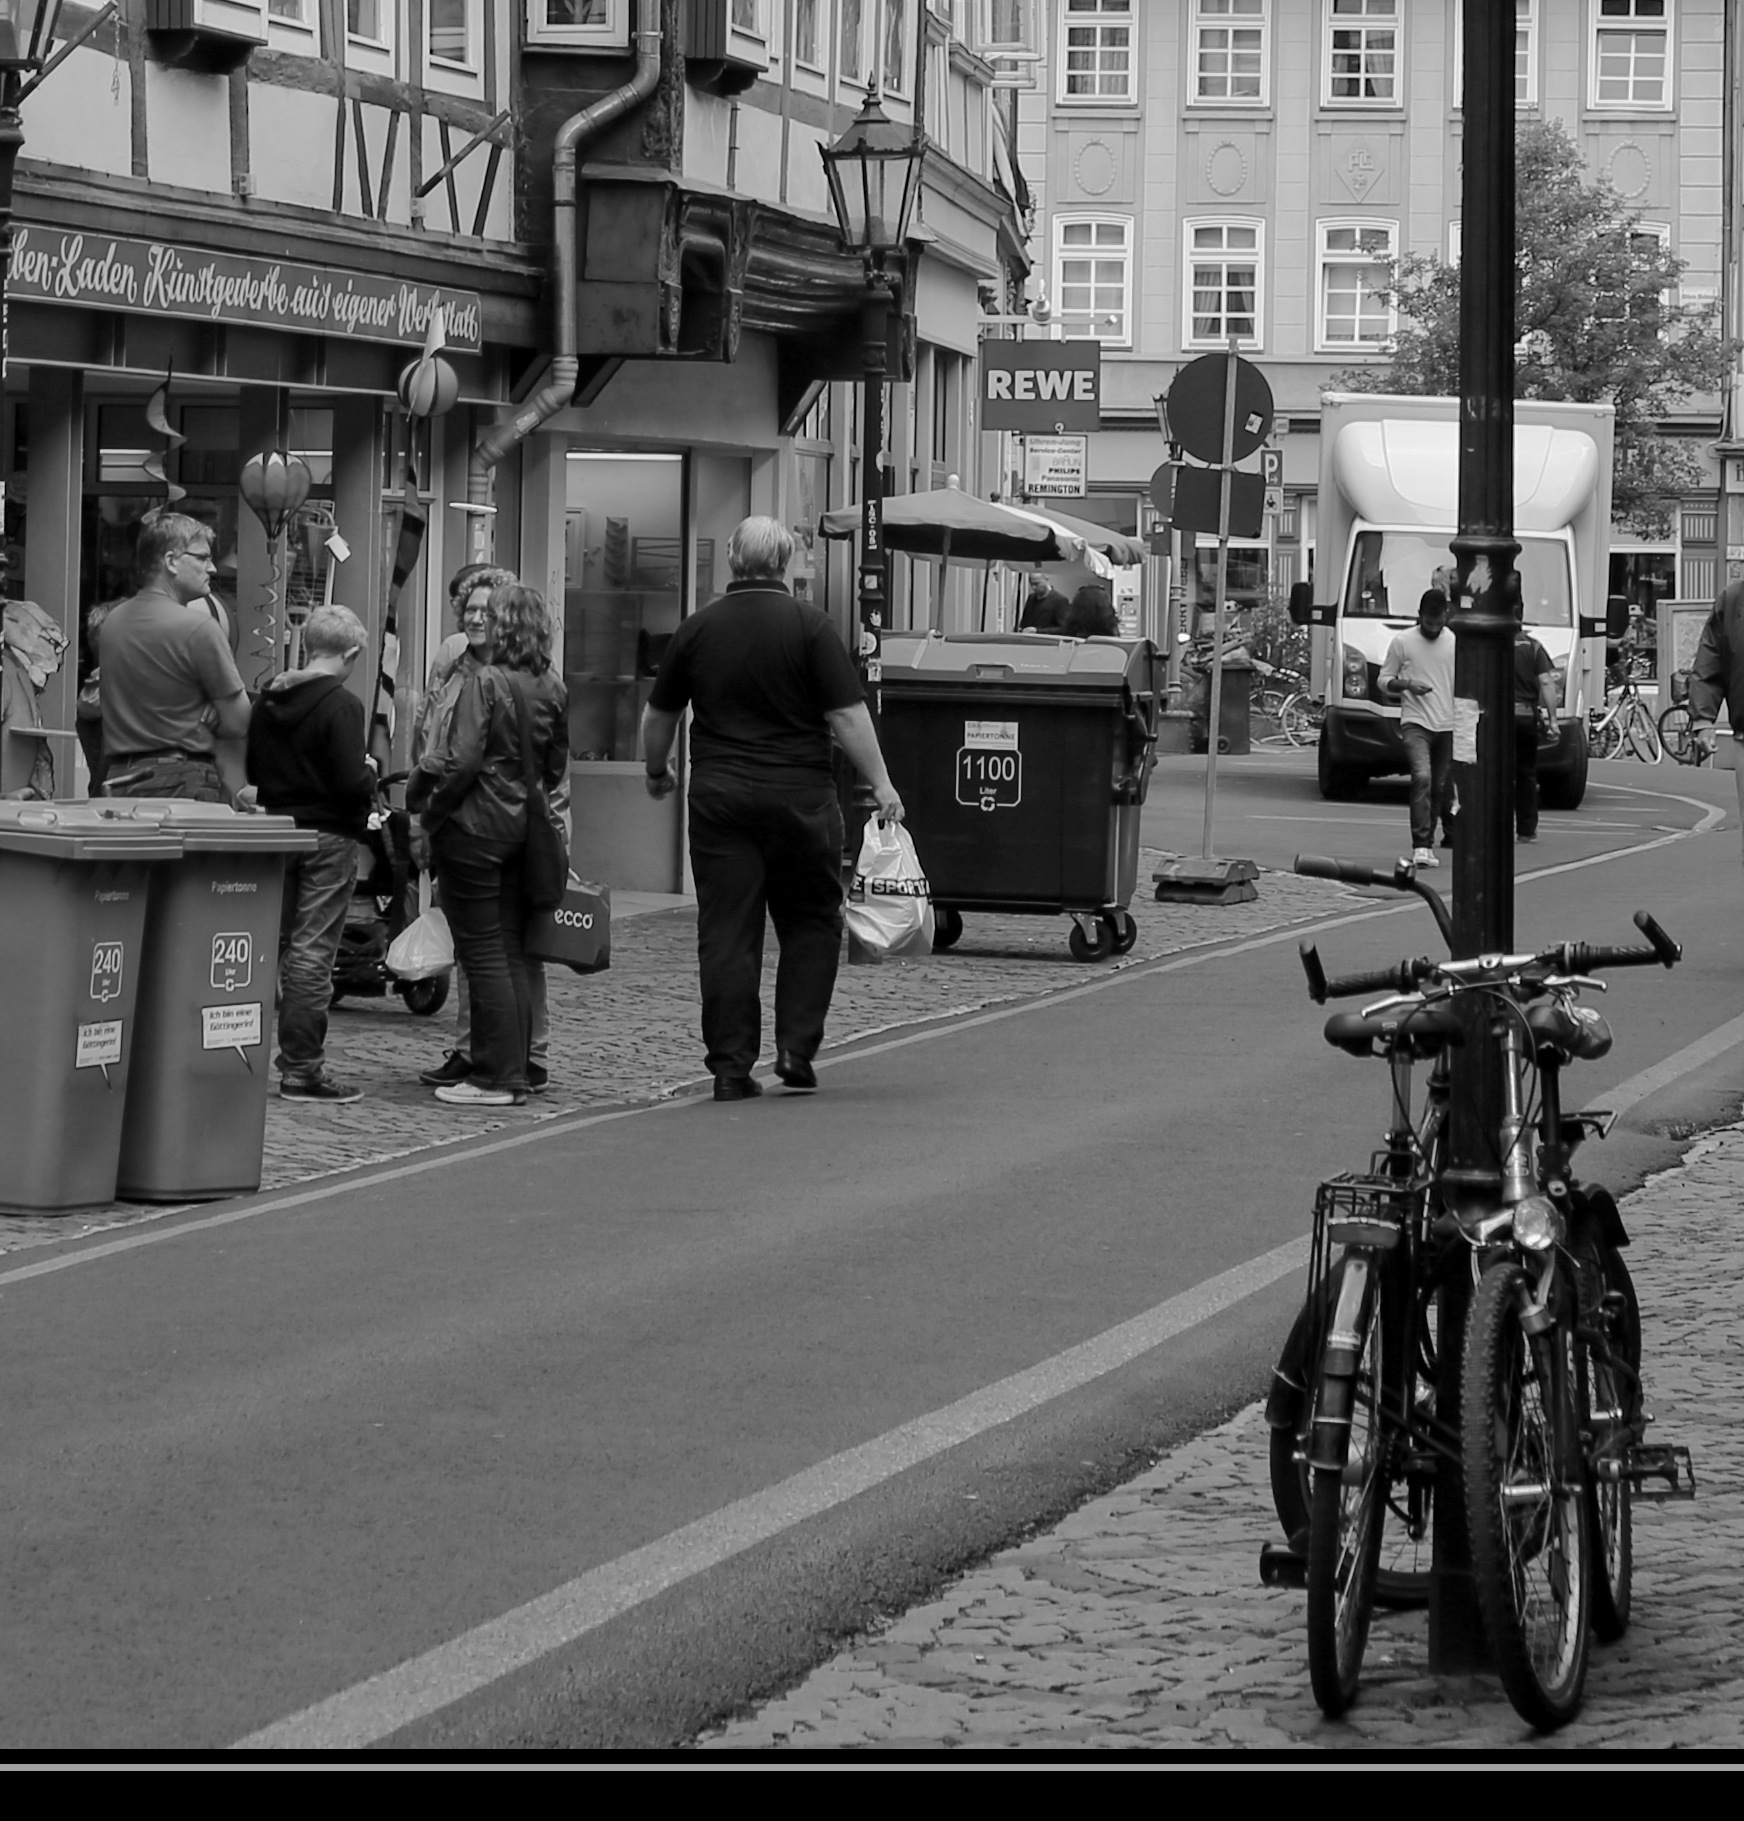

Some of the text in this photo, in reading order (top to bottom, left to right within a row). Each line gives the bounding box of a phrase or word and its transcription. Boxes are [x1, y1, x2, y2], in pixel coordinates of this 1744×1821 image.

[332, 279, 396, 333] eigener
[987, 369, 1096, 401] REWE
[1048, 467, 1081, 475] PHILIPS
[1265, 453, 1278, 484] P
[1028, 483, 1081, 494] REMINGTON
[966, 732, 1016, 741] PAPIERTONNE
[962, 755, 1015, 781] 1100
[979, 787, 997, 795] Liter
[211, 881, 257, 895] Papiertonne
[554, 909, 593, 929] ecco
[94, 948, 120, 974] 240
[214, 938, 248, 964] 240
